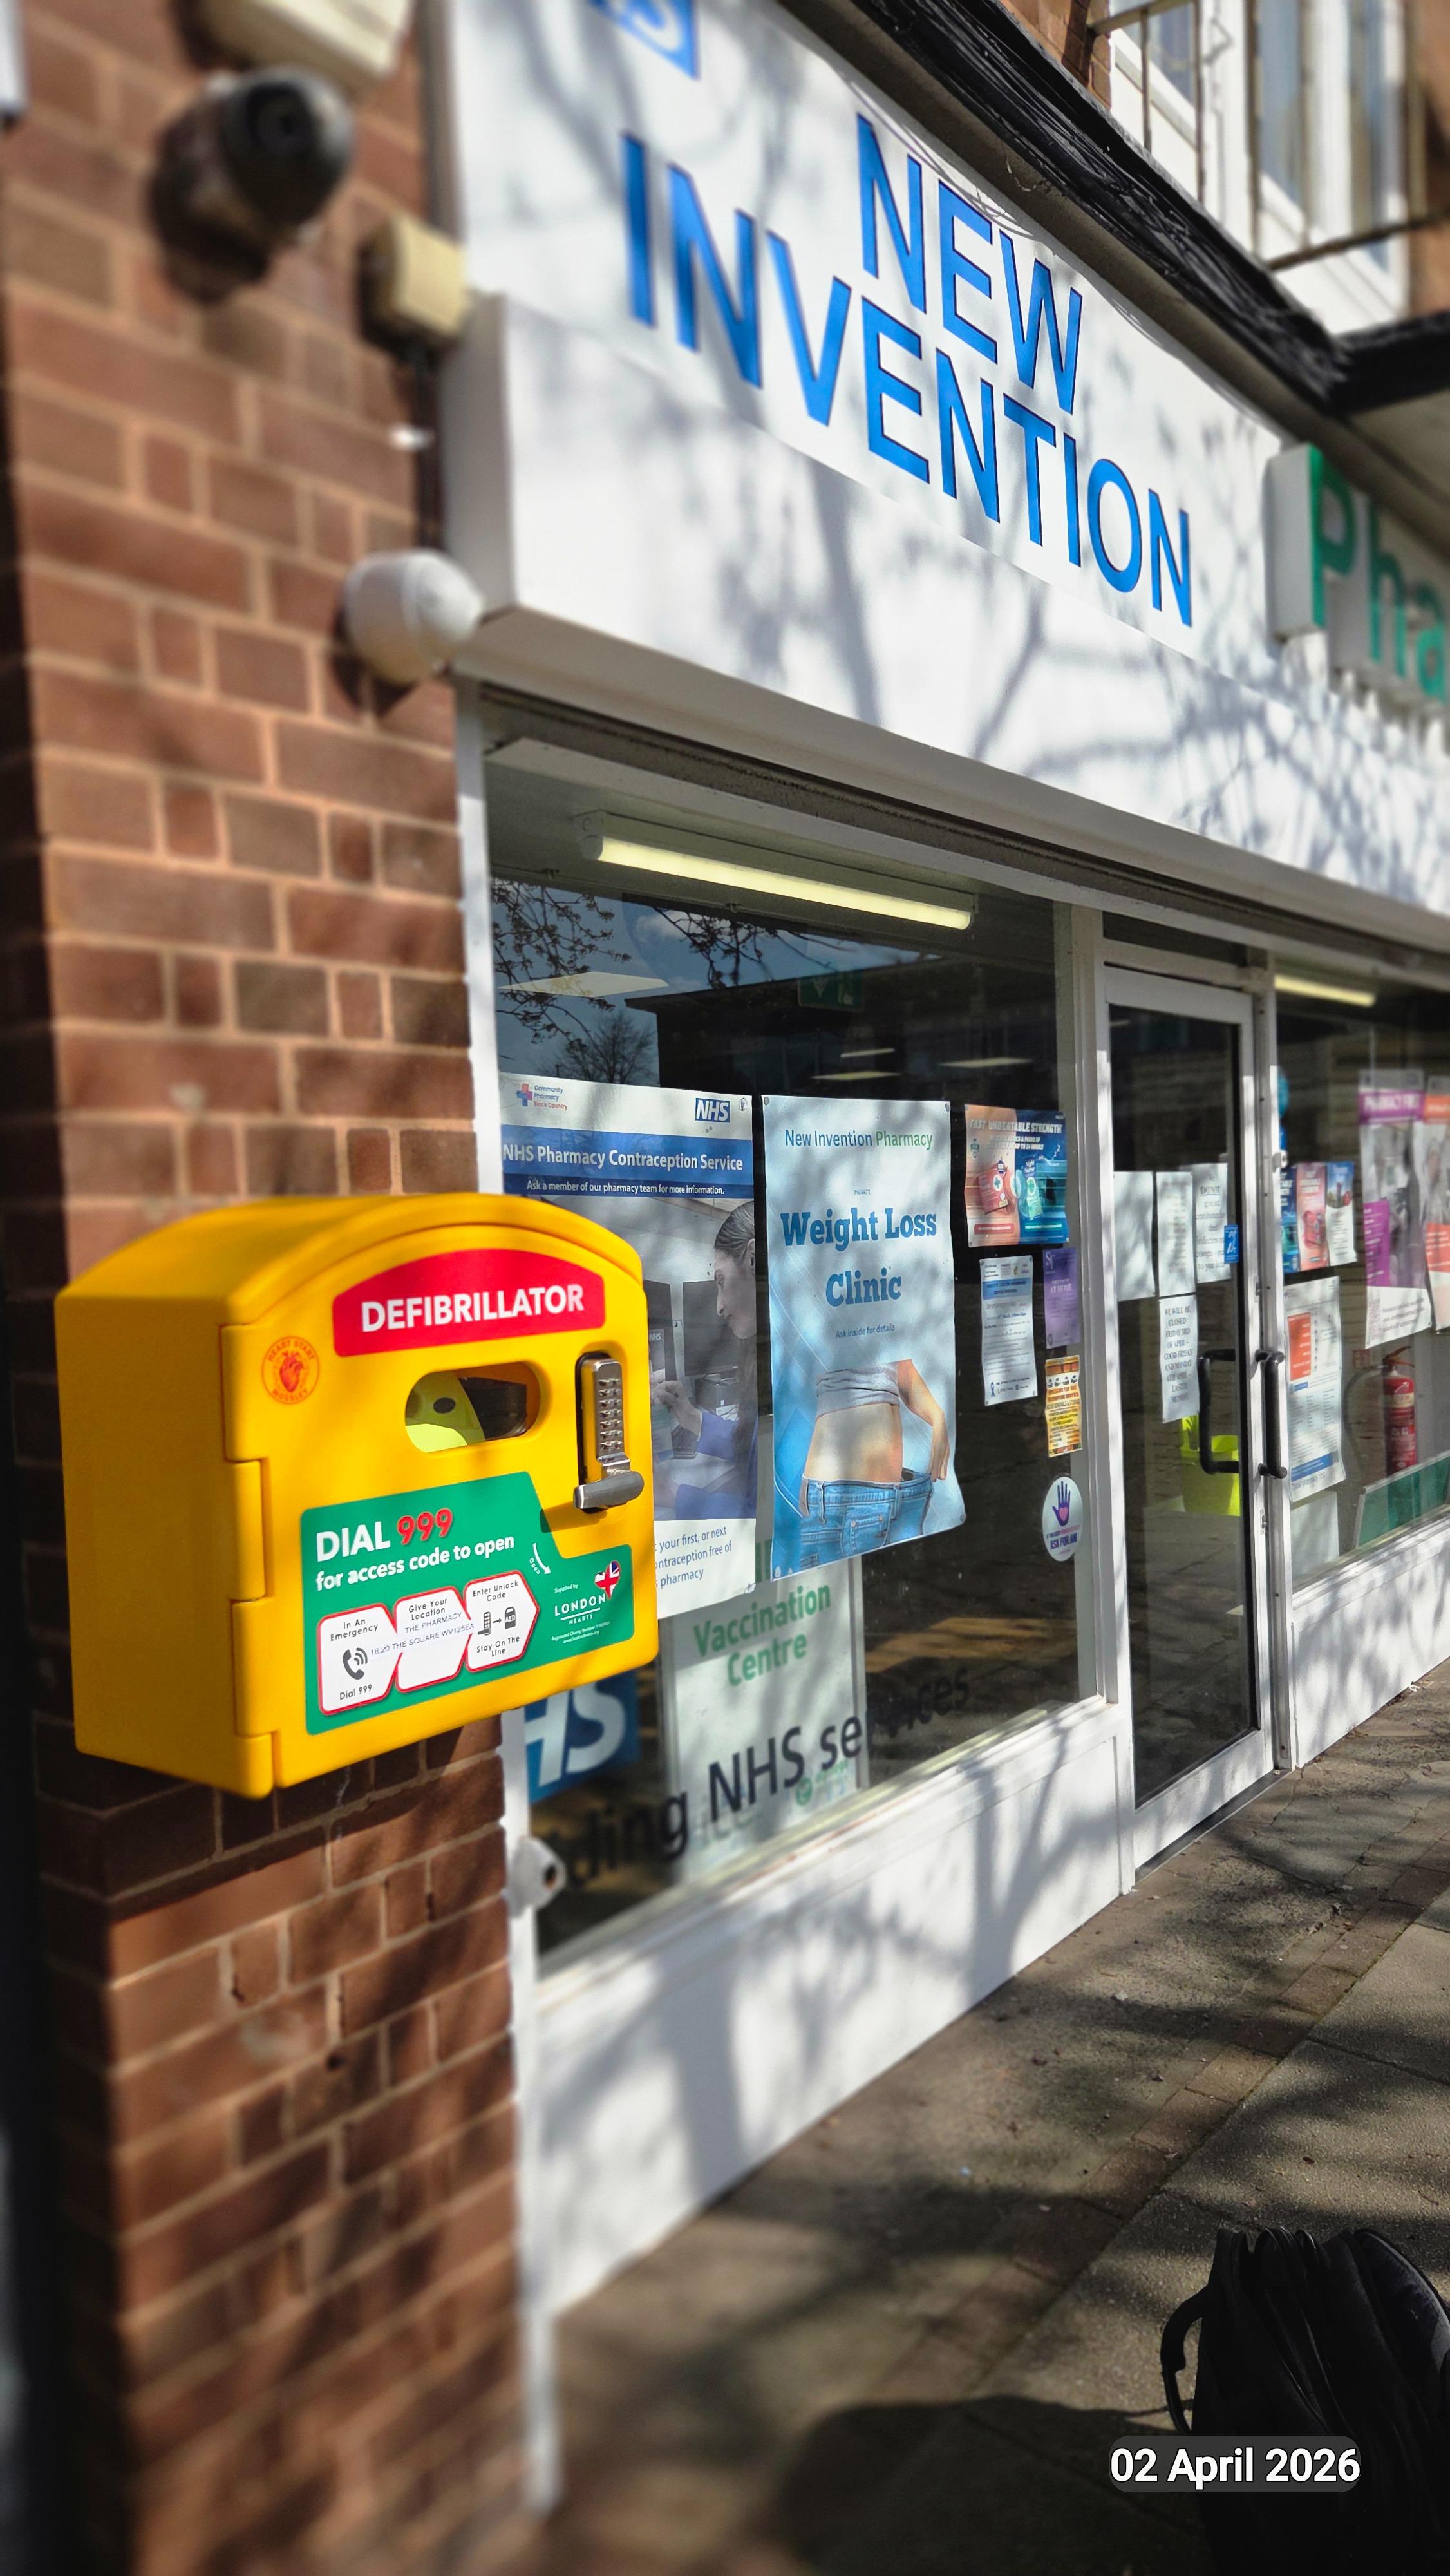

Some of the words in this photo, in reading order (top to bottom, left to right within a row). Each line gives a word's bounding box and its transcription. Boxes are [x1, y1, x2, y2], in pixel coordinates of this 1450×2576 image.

[858, 113, 1082, 414] NEW
[621, 132, 1192, 627] INVENTION
[534, 1085, 563, 1094] Community
[534, 1093, 559, 1102] Pharmacy
[696, 1099, 730, 1122] NHS
[969, 1120, 986, 1130] FAST
[988, 1121, 1030, 1132] UNBEATABLE
[785, 1130, 811, 1147] New
[814, 1130, 872, 1147] Invention
[876, 1130, 932, 1150] Pharmacy
[503, 1144, 534, 1162] NHS
[538, 1146, 605, 1169] Pharmacy
[609, 1150, 698, 1171] Contraception
[701, 1154, 743, 1171] Service
[527, 1180, 540, 1190] Ask
[549, 1181, 578, 1191] member
[581, 1182, 588, 1191] of
[603, 1182, 639, 1195] pharmacy
[639, 1184, 657, 1193] team
[658, 1184, 668, 1193] for
[686, 1185, 724, 1195] information.
[780, 1208, 878, 1252] Weight
[885, 1208, 937, 1239] Loss
[825, 1267, 901, 1307] Clinic
[361, 1284, 585, 1332] DEFIBRILLATOR
[835, 1329, 846, 1339] Ask
[847, 1327, 865, 1337] inside
[866, 1326, 875, 1335] for
[876, 1324, 895, 1334] details
[267, 1340, 290, 1361] HEART
[294, 1340, 315, 1360] START
[272, 1388, 308, 1402] MOSSLEY
[316, 1522, 391, 1562] DIAL
[397, 1508, 453, 1546] 999
[659, 1541, 679, 1553] your
[681, 1533, 700, 1548] first,
[702, 1531, 710, 1540] or
[711, 1526, 727, 1539] next
[315, 1570, 341, 1591] for
[347, 1559, 405, 1585] access
[408, 1548, 451, 1571] code
[453, 1544, 471, 1561] to
[474, 1536, 515, 1559] open
[655, 1549, 708, 1570] ontraception
[709, 1545, 723, 1558] free
[724, 1540, 733, 1553] of
[473, 1588, 491, 1597] Enter
[494, 1580, 519, 1591] Unlock
[554, 1584, 572, 1593] Supplied
[660, 1567, 704, 1589] pharmacy
[408, 1602, 426, 1613] Give
[430, 1598, 447, 1608] Your
[487, 1593, 506, 1602] Code
[554, 1593, 606, 1616] LONDON
[405, 1624, 419, 1634] THE
[422, 1612, 462, 1629] PHARMACY
[411, 1607, 446, 1621] Location
[569, 1614, 593, 1625] HEARTS
[693, 1584, 831, 1658] Vaccination
[330, 1624, 378, 1642] Emergency
[391, 1641, 407, 1650] THE
[409, 1633, 440, 1646] SQUARE
[442, 1623, 475, 1637] WV125EA
[477, 1645, 492, 1653] Stay
[507, 1636, 520, 1644] The
[491, 1648, 506, 1657] Line
[726, 1633, 807, 1687] Centre
[339, 1689, 355, 1700] Dial
[358, 1684, 373, 1694] 999
[525, 1680, 626, 1788] HS
[708, 1726, 804, 1823] NHS
